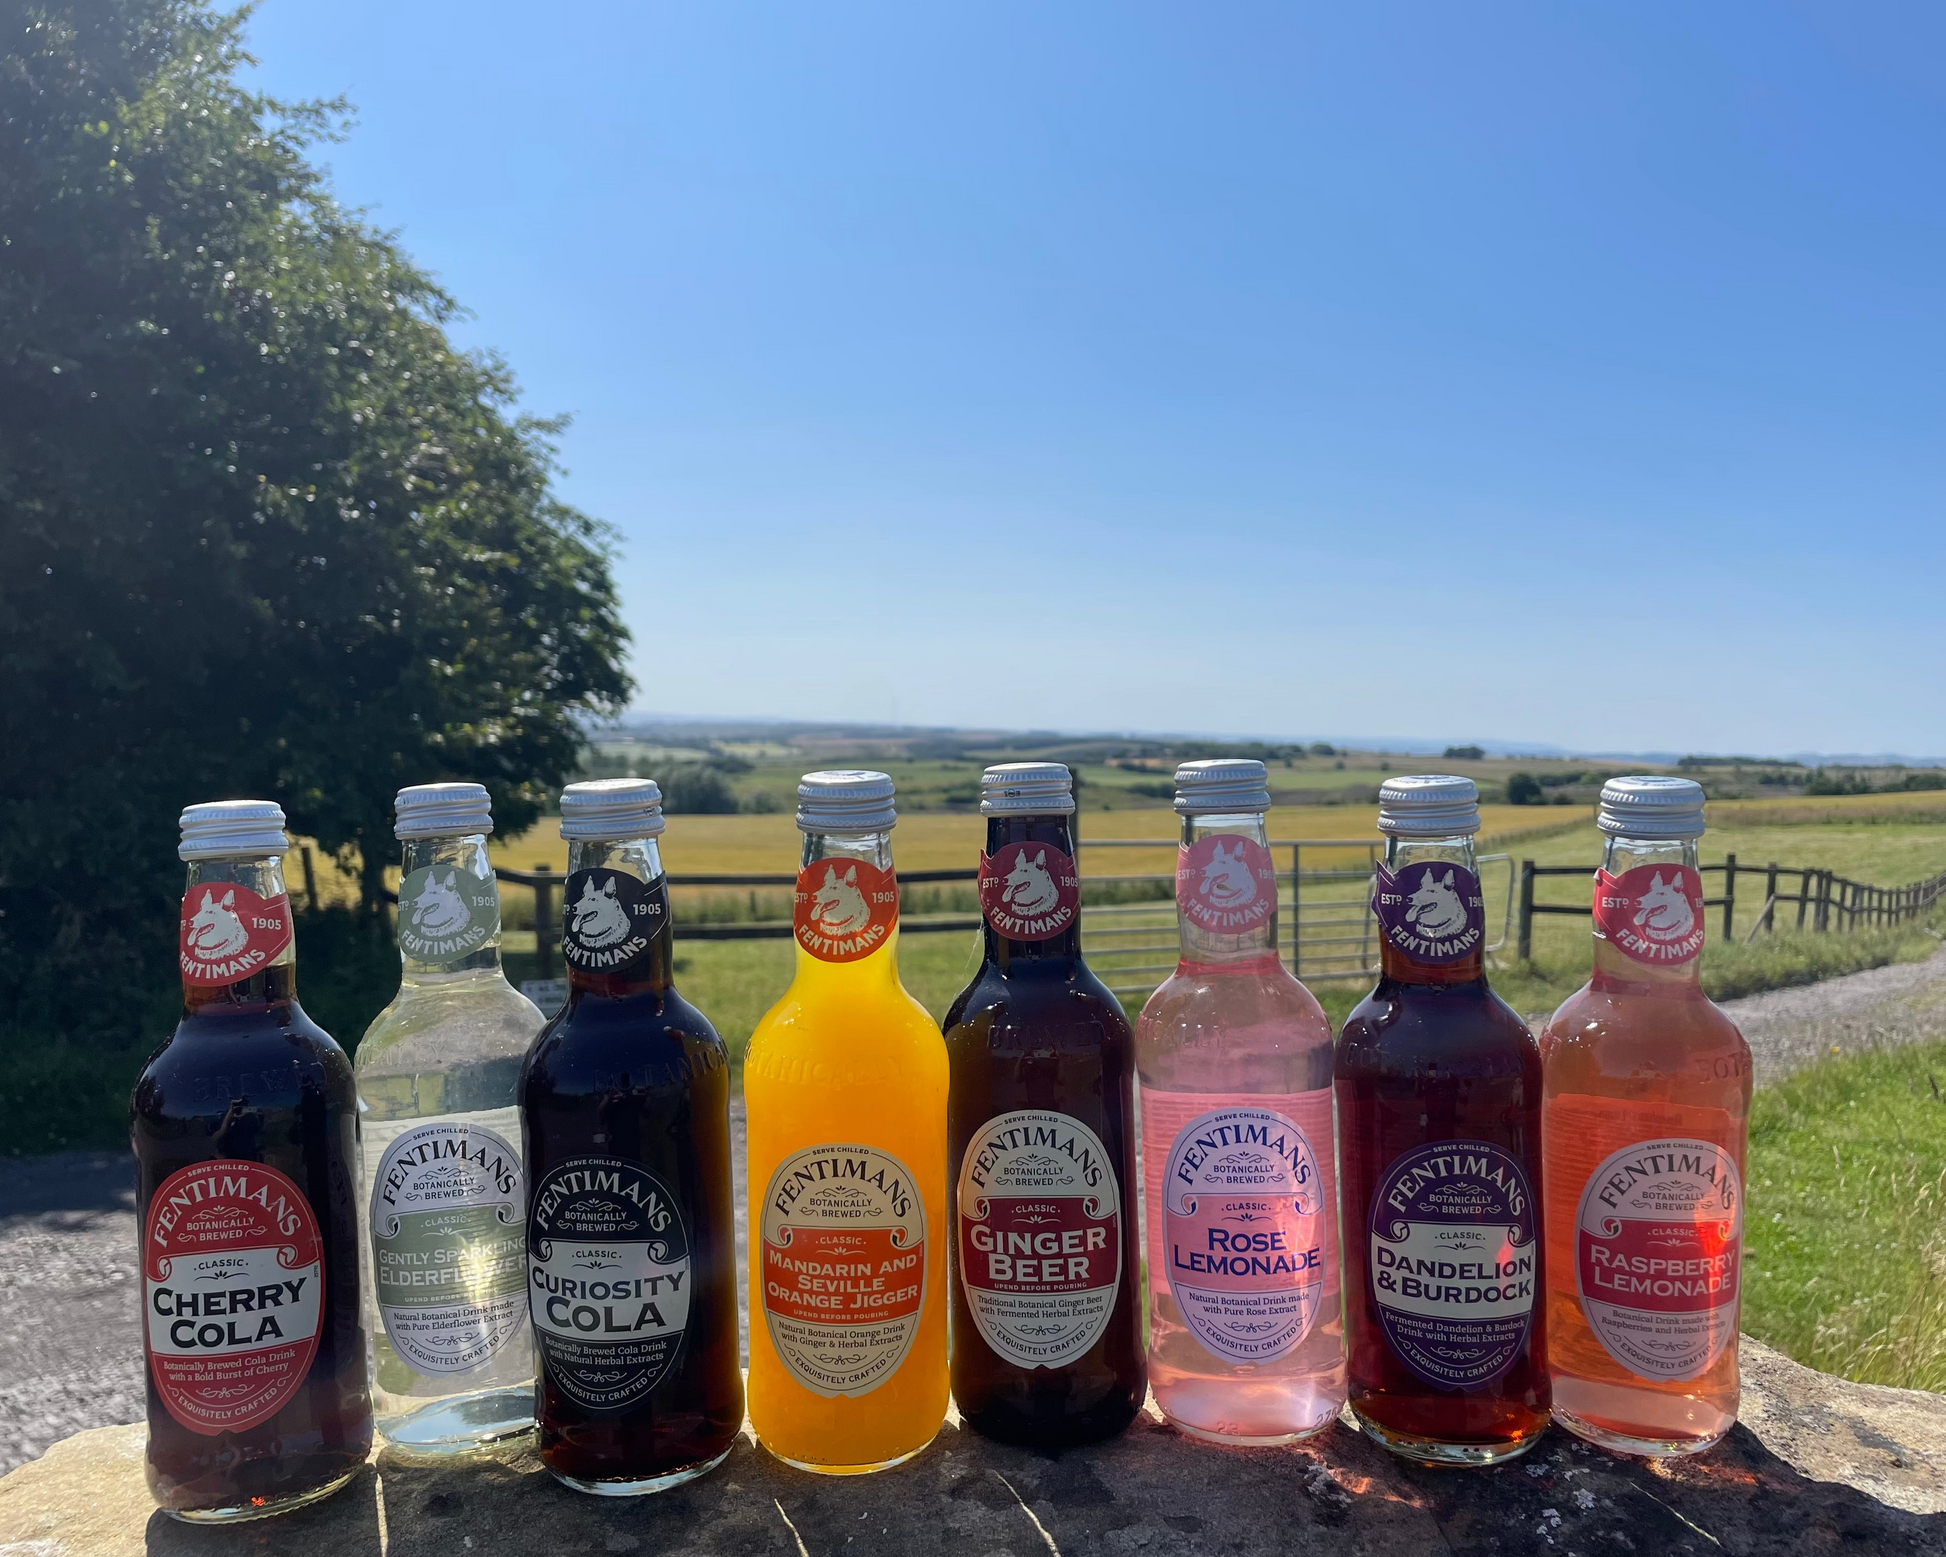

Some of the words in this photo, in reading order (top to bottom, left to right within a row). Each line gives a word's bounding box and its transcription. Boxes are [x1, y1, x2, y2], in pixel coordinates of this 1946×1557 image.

[472, 896, 495, 907] 1905
[872, 892, 894, 903] 1905
[633, 904, 661, 915] 1905
[1187, 898, 1269, 926] FENTIMANS
[252, 918, 281, 930] 1905
[990, 906, 1071, 934] FENTIMANS
[402, 926, 485, 954] FENTIMANS
[799, 924, 884, 955] FENTIMANS
[1391, 924, 1479, 956] FENTIMANS
[1616, 928, 1703, 959] FENTIMANS
[563, 935, 647, 967] FENTIMANS
[180, 949, 265, 979] FENTIMANS
[1004, 1116, 1026, 1124] SERVE
[1215, 1114, 1237, 1122] SERVE
[413, 1130, 435, 1140] SERVE
[813, 1148, 835, 1156] SERVE
[971, 1127, 1102, 1189] FENTIMANS
[1178, 1124, 1311, 1186] FENTIMANS
[188, 1165, 211, 1176] SERVE
[383, 1140, 516, 1206] FENTIMANS
[566, 1160, 587, 1168] SERVE
[589, 1159, 622, 1167] CHILLED
[1004, 1167, 1064, 1175] BOTANICALLY
[1214, 1164, 1274, 1173] BOTANICALLY
[413, 1177, 475, 1190] BOTANICALLY
[775, 1159, 911, 1217] FENTIMANS
[1015, 1178, 1054, 1186] BREWED
[1226, 1175, 1265, 1183] BREWED
[1388, 1156, 1525, 1216] FENTIMANS
[1599, 1154, 1735, 1210] FENTIMANS
[425, 1189, 464, 1200] BREWED
[536, 1170, 672, 1232] FENTIMANS
[810, 1198, 872, 1207] BOTANICALLY
[1429, 1194, 1492, 1204] BOTANICALLY
[1642, 1191, 1705, 1201] BOTANICALLY
[154, 1176, 302, 1247] FENTIMANS
[822, 1209, 861, 1218] BREWED
[1442, 1205, 1482, 1214] BREWED
[1655, 1202, 1695, 1210] BREWED
[187, 1217, 254, 1231] BOTANICALLY
[565, 1211, 627, 1221] BOTANICALLY
[200, 1230, 243, 1241] BREWED
[576, 1223, 616, 1231] BREWED
[971, 1225, 1106, 1255] GINGER
[1208, 1228, 1286, 1252] ROSE
[379, 1249, 429, 1264] GENTLY
[770, 1250, 871, 1276] MANDARIN
[879, 1254, 917, 1274] AND
[1174, 1244, 1321, 1276] LEMONADE
[1377, 1245, 1531, 1280] DANDELION
[988, 1252, 1090, 1282] BEER
[533, 1266, 685, 1300] CURIOSITY
[798, 1276, 885, 1293] SEVILLE
[1054, 1282, 1087, 1290] POURING
[1594, 1266, 1731, 1297] LEMONADE
[154, 1277, 307, 1317] CHERRY
[768, 1282, 843, 1309] ORANGE
[850, 1285, 917, 1308] JIGGER
[978, 1295, 1016, 1308] Traditional
[1018, 1298, 1056, 1308] Botanical
[1058, 1298, 1084, 1310] Ginger
[1087, 1295, 1102, 1304] Beer
[1189, 1292, 1219, 1304] Natural
[1221, 1295, 1261, 1305] Botanical
[1263, 1295, 1286, 1305] Drink
[394, 1312, 420, 1321] Natural
[422, 1309, 460, 1320] Botanical
[463, 1307, 489, 1317] Drink
[547, 1296, 666, 1333] COLA
[794, 1310, 818, 1318] UPEND
[854, 1311, 888, 1320] POURING
[980, 1306, 995, 1315] with
[997, 1308, 1039, 1318] Fermented
[1042, 1308, 1069, 1318] Herbal
[1072, 1305, 1103, 1316] Extracts
[1203, 1305, 1222, 1314] with
[1224, 1306, 1244, 1315] Pure
[1246, 1306, 1267, 1315] Rose
[1269, 1305, 1297, 1314] Extract
[1613, 1310, 1653, 1323] Botanical
[396, 1322, 410, 1330] with
[412, 1321, 429, 1331] Pure
[432, 1317, 481, 1329] Elderflower
[484, 1311, 513, 1321] Extract
[779, 1321, 805, 1336] Natural
[808, 1329, 847, 1338] Botanical
[849, 1330, 880, 1340] Orange
[883, 1323, 905, 1335] Drink
[1386, 1312, 1433, 1330] Fermented
[1436, 1323, 1483, 1333] Dandelion
[1602, 1317, 1652, 1332] Raspberries
[170, 1316, 284, 1348] COLA
[781, 1332, 797, 1343] with
[799, 1336, 826, 1348] Ginger
[838, 1339, 867, 1348] Herbal
[870, 1334, 902, 1346] Extracts
[1206, 1327, 1258, 1352] EXQUISITELY
[1261, 1327, 1296, 1351] CRAFTED
[1397, 1324, 1423, 1338] Drink
[1426, 1332, 1446, 1341] with
[1450, 1334, 1480, 1343] Herbal
[1482, 1332, 1515, 1342] Extracts
[409, 1344, 459, 1365] EXQUISITELY
[462, 1335, 500, 1363] CRAFTED
[546, 1337, 581, 1354] Botanically
[584, 1346, 615, 1355] Brewed
[618, 1345, 638, 1354] Cola
[641, 1341, 666, 1352] Drink
[997, 1330, 1047, 1355] EXQUISITELY
[1050, 1330, 1085, 1353] CRAFTED
[164, 1361, 205, 1373] Botanically
[208, 1359, 241, 1370] Brewed
[245, 1356, 266, 1366] Cola
[269, 1349, 295, 1364] Drink
[565, 1353, 592, 1365] Natural
[595, 1355, 624, 1365] Herbal
[627, 1352, 664, 1364] Extracts
[1411, 1349, 1464, 1378] EXQUISITELY
[1467, 1355, 1504, 1377] CRAFTED
[1620, 1343, 1675, 1369] EXQUISITELY
[170, 1372, 186, 1382] with
[195, 1371, 213, 1381] Bold
[217, 1369, 241, 1380] Burst
[257, 1362, 289, 1376] Cherry
[795, 1357, 846, 1384] EXQUISITELY
[849, 1358, 886, 1382] CRAFTED
[559, 1373, 606, 1402] EXQUISITELY
[609, 1377, 648, 1401] CRAFTED
[178, 1396, 232, 1419] EXQUISITELY
[235, 1387, 277, 1416] CRAFTED
